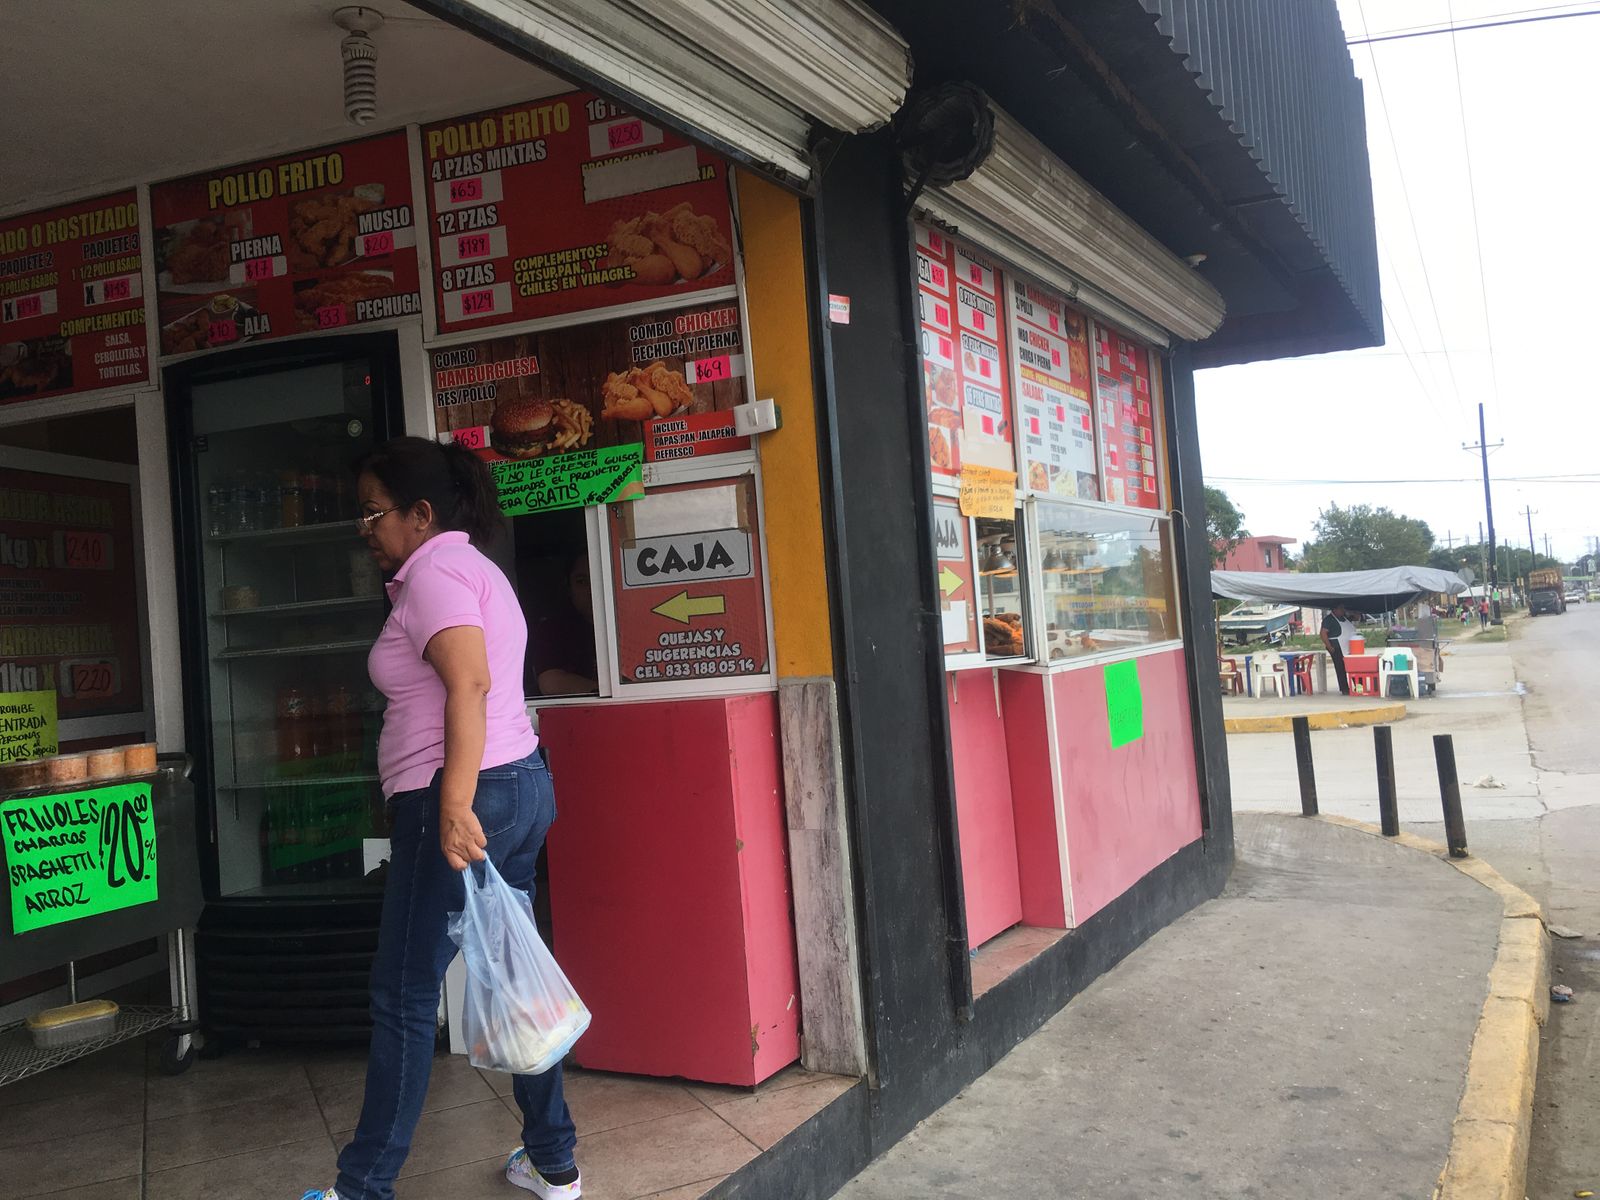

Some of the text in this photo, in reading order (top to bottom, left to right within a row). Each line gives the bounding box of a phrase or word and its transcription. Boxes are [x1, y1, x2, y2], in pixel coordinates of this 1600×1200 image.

[428, 101, 571, 161] POLLO FRITO
[431, 160, 444, 183] 4
[444, 153, 484, 181] PZAS
[487, 139, 549, 172] MIXTAS
[207, 152, 345, 210] POLLO FRITO
[32, 222, 44, 249] O
[46, 202, 140, 246] ROSTIZADO
[356, 205, 412, 235] MUSLO
[437, 204, 499, 236] 12 PZAS
[83, 232, 140, 260] PAQUETE 3
[230, 234, 284, 262] PIERNA
[512, 243, 608, 272] COMPLEMENTOS:
[0, 250, 54, 278] PAQUETE 2
[442, 262, 496, 292] 8 PZAS
[588, 259, 598, 273] Y
[519, 265, 638, 297] CHILES EN VINAGRE.
[356, 292, 422, 321] PECHUGA
[243, 314, 271, 337] ALA
[629, 306, 739, 342] COMBO CHICKEN
[434, 348, 478, 369] COMBO
[632, 329, 741, 363] PECHUGA Y PIERNA
[436, 356, 542, 389] HAMBURGUESA
[696, 359, 723, 381] $69
[436, 384, 498, 408] RES/POLLO
[491, 459, 545, 476] ESTIMADO
[552, 450, 599, 465] CLIENTE
[507, 471, 524, 483] NO
[530, 468, 543, 480] LE
[604, 452, 639, 465] GUISOS
[654, 446, 696, 461] REFRESCO
[552, 475, 564, 485] EL
[570, 464, 620, 483] PRODUCTO
[501, 482, 580, 510] ERA GRATIS
[936, 519, 959, 548] AJA
[637, 540, 734, 577] CAJA
[658, 628, 725, 647] QUEJAS Y
[645, 643, 742, 664] SUGERENCIAS
[635, 664, 663, 680] CEL.
[665, 662, 690, 678] 833
[692, 661, 717, 675] 188
[719, 660, 737, 674] 05
[3, 797, 101, 837] FRIJOLES
[14, 830, 88, 855] CHARROS
[10, 850, 98, 888] SPAGHETTI
[24, 882, 92, 914] ARROZ
